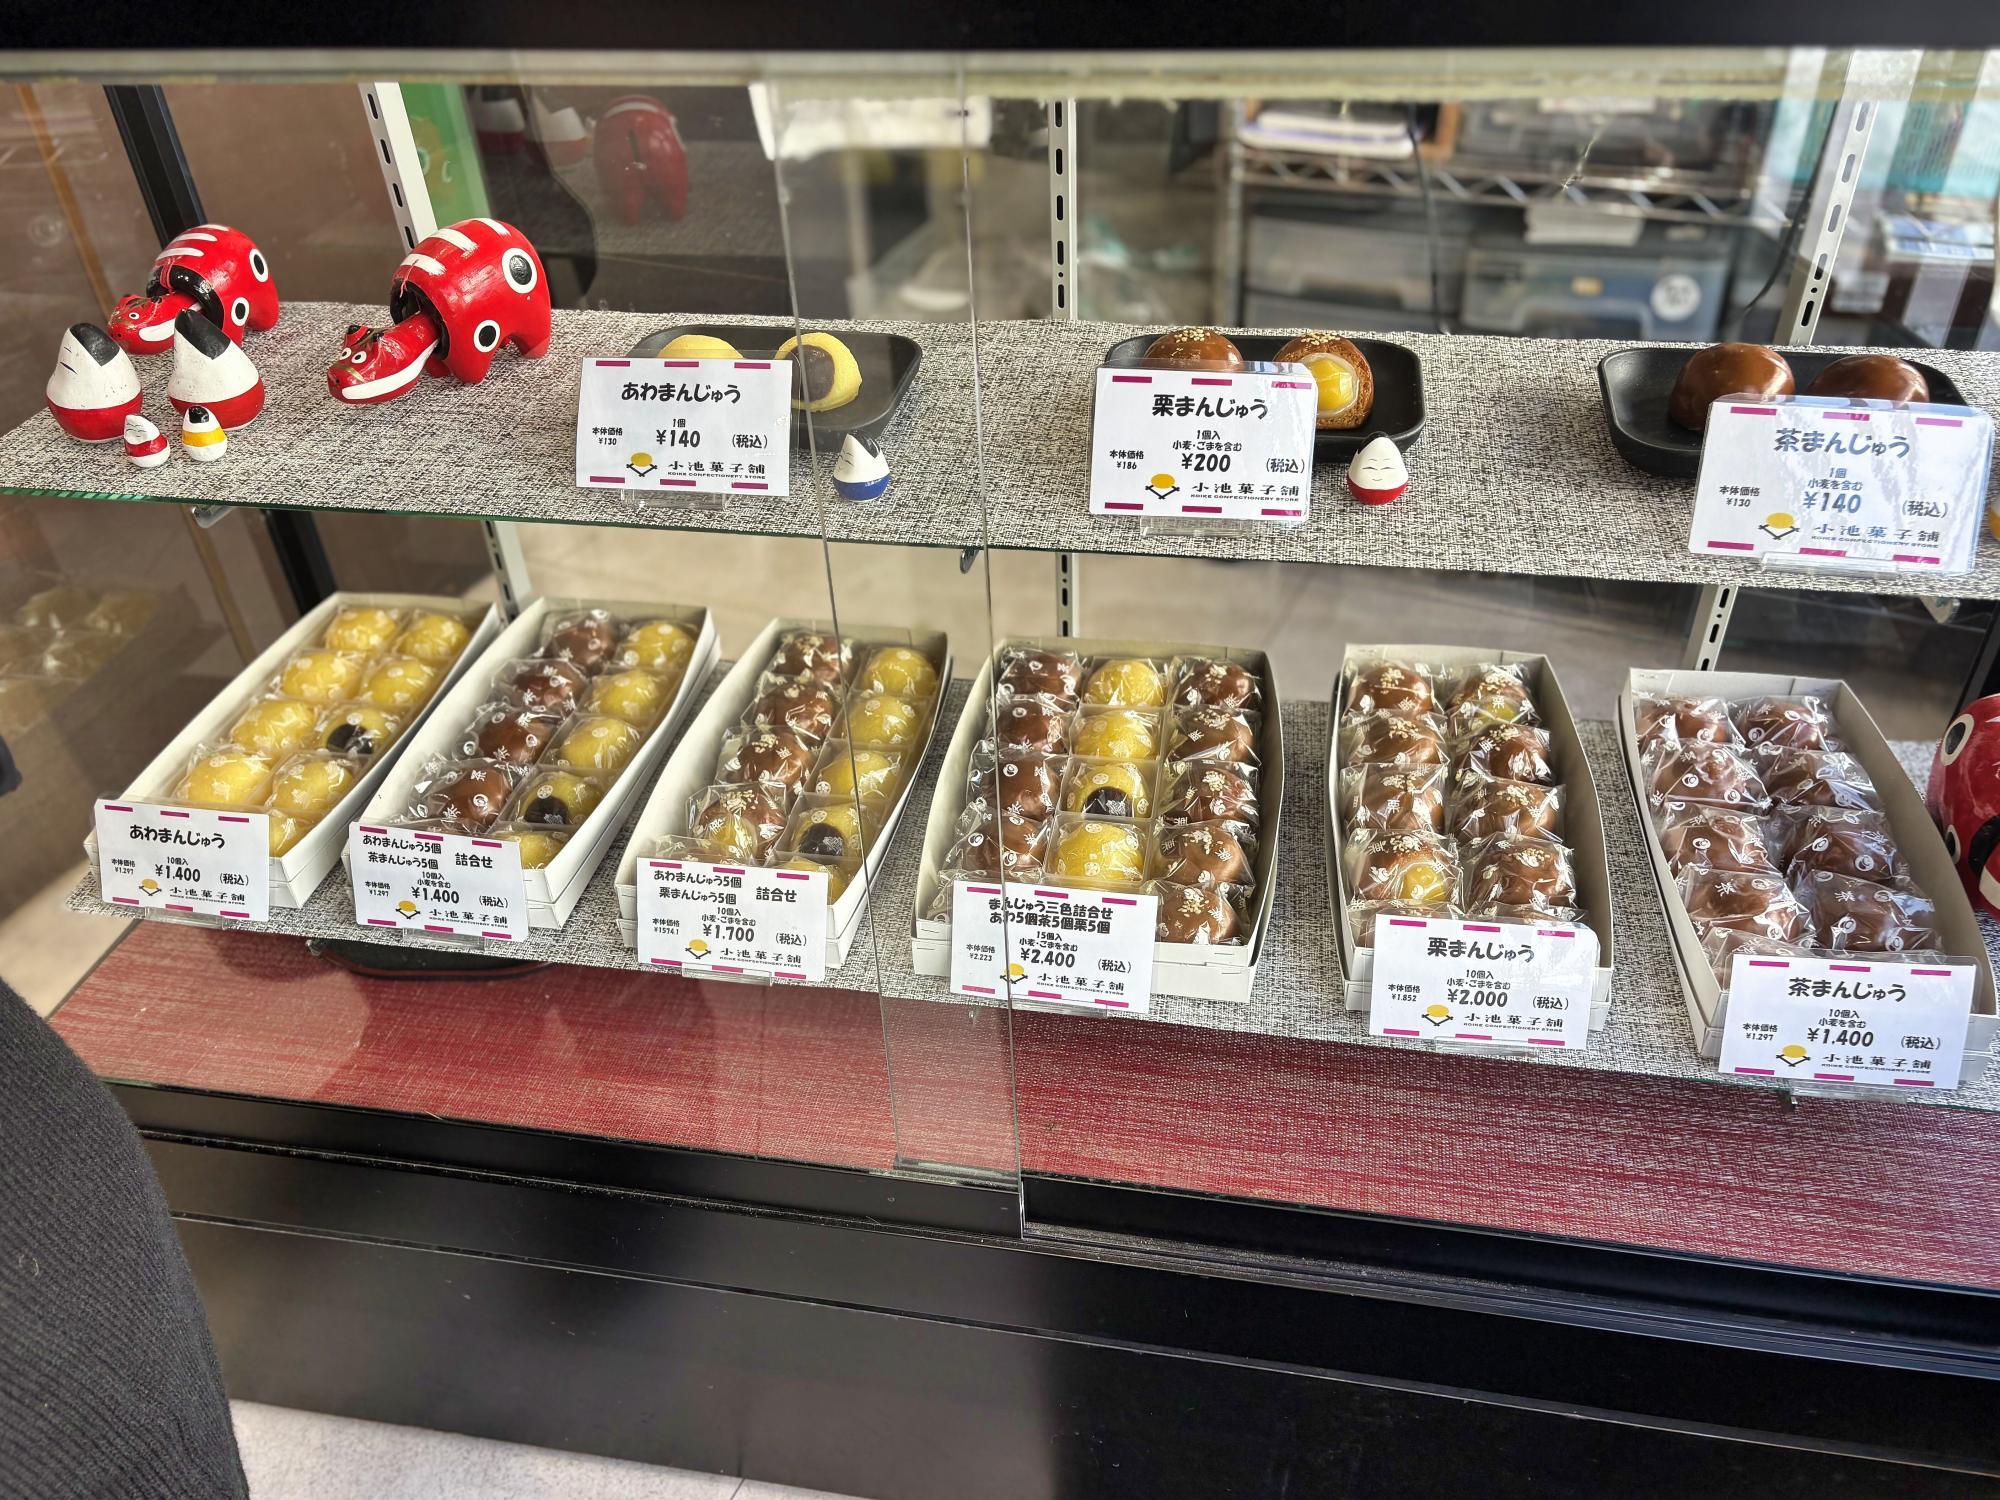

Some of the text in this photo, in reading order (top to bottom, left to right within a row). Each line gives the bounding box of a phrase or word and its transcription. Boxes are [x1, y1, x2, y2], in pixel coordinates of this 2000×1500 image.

[621, 381, 740, 404] あわまんじゅう
[1152, 394, 1269, 420] 栗まんじゅう
[672, 419, 686, 428] 1個
[592, 427, 623, 436] 本体価格
[1196, 430, 1221, 440] 1個入
[599, 437, 617, 446] ¥130
[656, 430, 701, 448] ¥140
[732, 434, 768, 449] (税込)
[1773, 427, 1910, 458] 茶まんじゅう
[1109, 450, 1145, 460] 本体価格
[1116, 461, 1137, 470] ¥186
[1181, 453, 1231, 473] ¥200
[1266, 458, 1305, 474] (税込)
[1829, 467, 1847, 478] 1個
[1719, 485, 1760, 497] 本体価格
[1807, 478, 1863, 492] 小麦を含む
[1726, 497, 1750, 507] ¥130
[1802, 491, 1861, 514] ¥140
[1902, 500, 1948, 519] (税込)
[130, 824, 225, 849] あわまんじゅう
[363, 835, 442, 854] あわまんじゅう5個
[111, 858, 136, 867] 本体価格
[167, 856, 188, 866] 10個入
[368, 851, 439, 870] 茶まんじゅう5個
[455, 853, 493, 869] 詰合せ
[219, 873, 249, 886] (税込)
[422, 871, 445, 881] 10個入
[654, 869, 742, 889] あわまんじゅう5個
[365, 881, 391, 890] 本体価格
[659, 886, 737, 905] 栗まんじゅう5個
[755, 886, 797, 903] 詰合せ
[479, 895, 509, 909] (税込)
[988, 897, 1113, 920] まんじゅう三色詰合せ
[717, 907, 742, 917] 10個入
[652, 917, 680, 928] 本体価格
[989, 911, 1110, 934] あわ5個茶5個栗5個
[775, 932, 807, 946] (税込)
[1036, 931, 1063, 942] 15個入
[966, 943, 996, 954] 本体価格
[1427, 936, 1535, 963] 栗まんじゅう
[1097, 958, 1132, 974] (税込)
[1465, 969, 1494, 980] 10個入
[1387, 983, 1421, 994] 本体価格
[1788, 976, 1906, 1003] 茶まんじゅう
[1532, 995, 1569, 1011] (税込)
[1828, 1008, 1860, 1019] 10個入
[1742, 1023, 1778, 1033] 本体価格
[1818, 1018, 1866, 1029] 小麦を含む
[1900, 1035, 1941, 1051] (税込)
